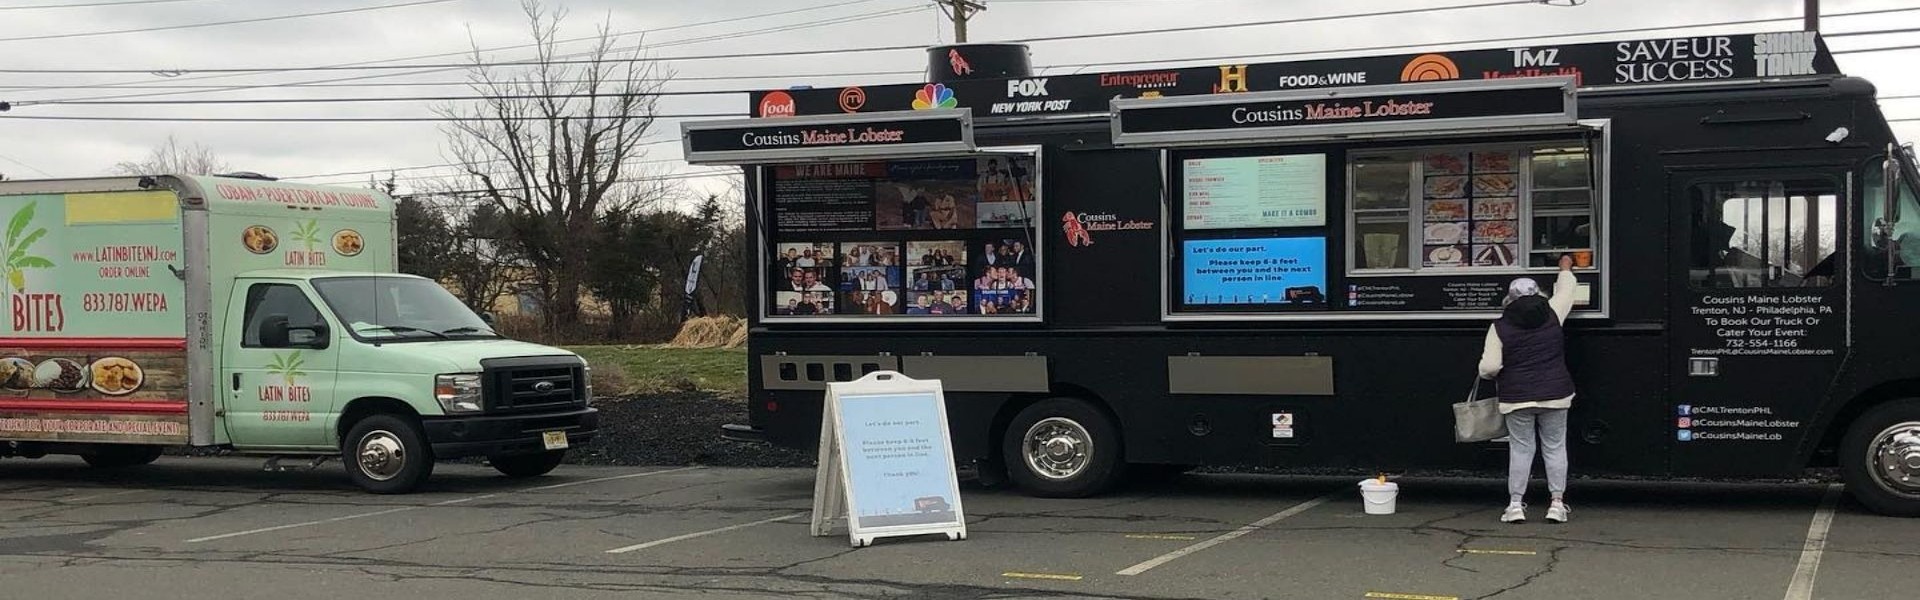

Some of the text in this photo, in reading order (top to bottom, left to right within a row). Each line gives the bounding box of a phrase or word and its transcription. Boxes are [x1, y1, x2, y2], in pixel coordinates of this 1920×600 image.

[1616, 36, 1734, 62] SAVEUR
[1754, 31, 1817, 54] SHARK
[1507, 48, 1560, 68] TMZ
[1754, 52, 1817, 76] TANK
[1615, 58, 1734, 83] SUCCESS
[1100, 72, 1180, 88] Entrepreneur
[1217, 65, 1248, 93] H
[1007, 78, 1049, 98] FOX
[763, 99, 794, 117] food
[991, 100, 1072, 114] NEW YORK POST
[1232, 99, 1434, 124] Cousins Maine Lobster
[742, 126, 904, 147] Cousins Maine Lobster
[216, 184, 256, 200] CUBAN
[1077, 212, 1117, 223] Cousins
[1087, 220, 1154, 231] Maine Lobster
[284, 251, 326, 266] LATIN BITES
[1240, 258, 1261, 267] keep
[1279, 257, 1298, 265] feet
[99, 266, 150, 278] ORDER ONLINE
[1196, 267, 1235, 275] between
[1236, 267, 1253, 275] you
[1290, 265, 1312, 273] next
[1222, 275, 1253, 283] person
[83, 293, 168, 312] 833.787.WEPA
[1702, 295, 1822, 305] Cousins Maine Lobster
[12, 293, 65, 332] BITES
[1691, 306, 1730, 315] Trenton,
[1732, 306, 1746, 315] NJ
[1756, 306, 1817, 316] Philadelphia,
[1819, 306, 1833, 314] PA
[1704, 317, 1820, 326] To Book Our Truck Or
[1716, 328, 1746, 337] Cater
[1748, 328, 1774, 337] Your
[1726, 339, 1798, 348] 732-554-1166
[258, 385, 311, 402] LATIN BITES
[1691, 406, 1773, 415] @CMLTrentonPHL
[1691, 419, 1799, 428] @CousinsMaineLobster
[1691, 431, 1782, 440] @CousinsMaineLob
